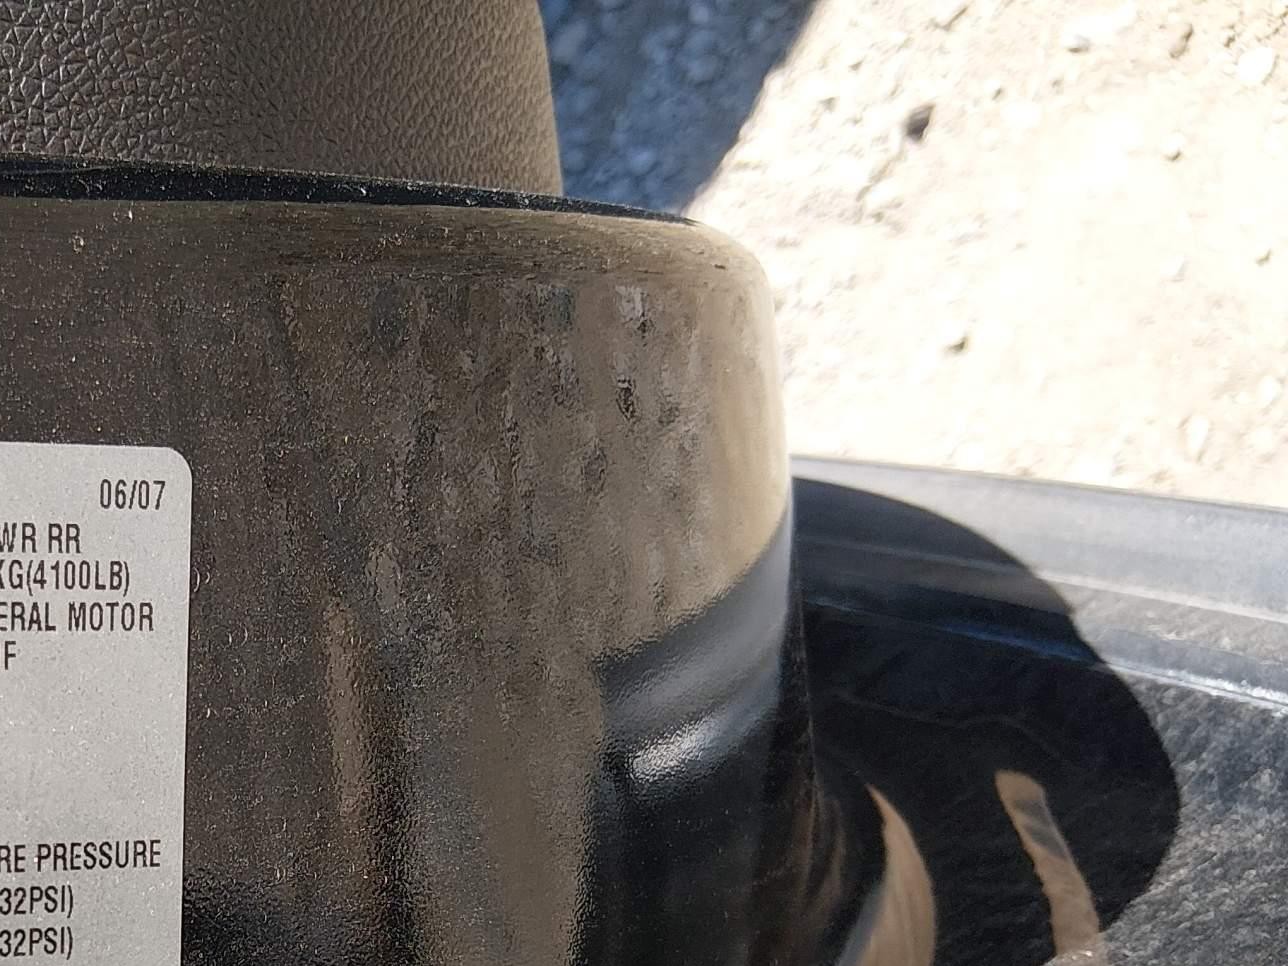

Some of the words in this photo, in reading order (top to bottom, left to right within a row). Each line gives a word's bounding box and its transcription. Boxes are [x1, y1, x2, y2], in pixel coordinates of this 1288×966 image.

[100, 479, 167, 510] 06/07
[48, 524, 81, 554] RR
[68, 603, 154, 632] MOTOR
[36, 840, 161, 872] PRESSURE
